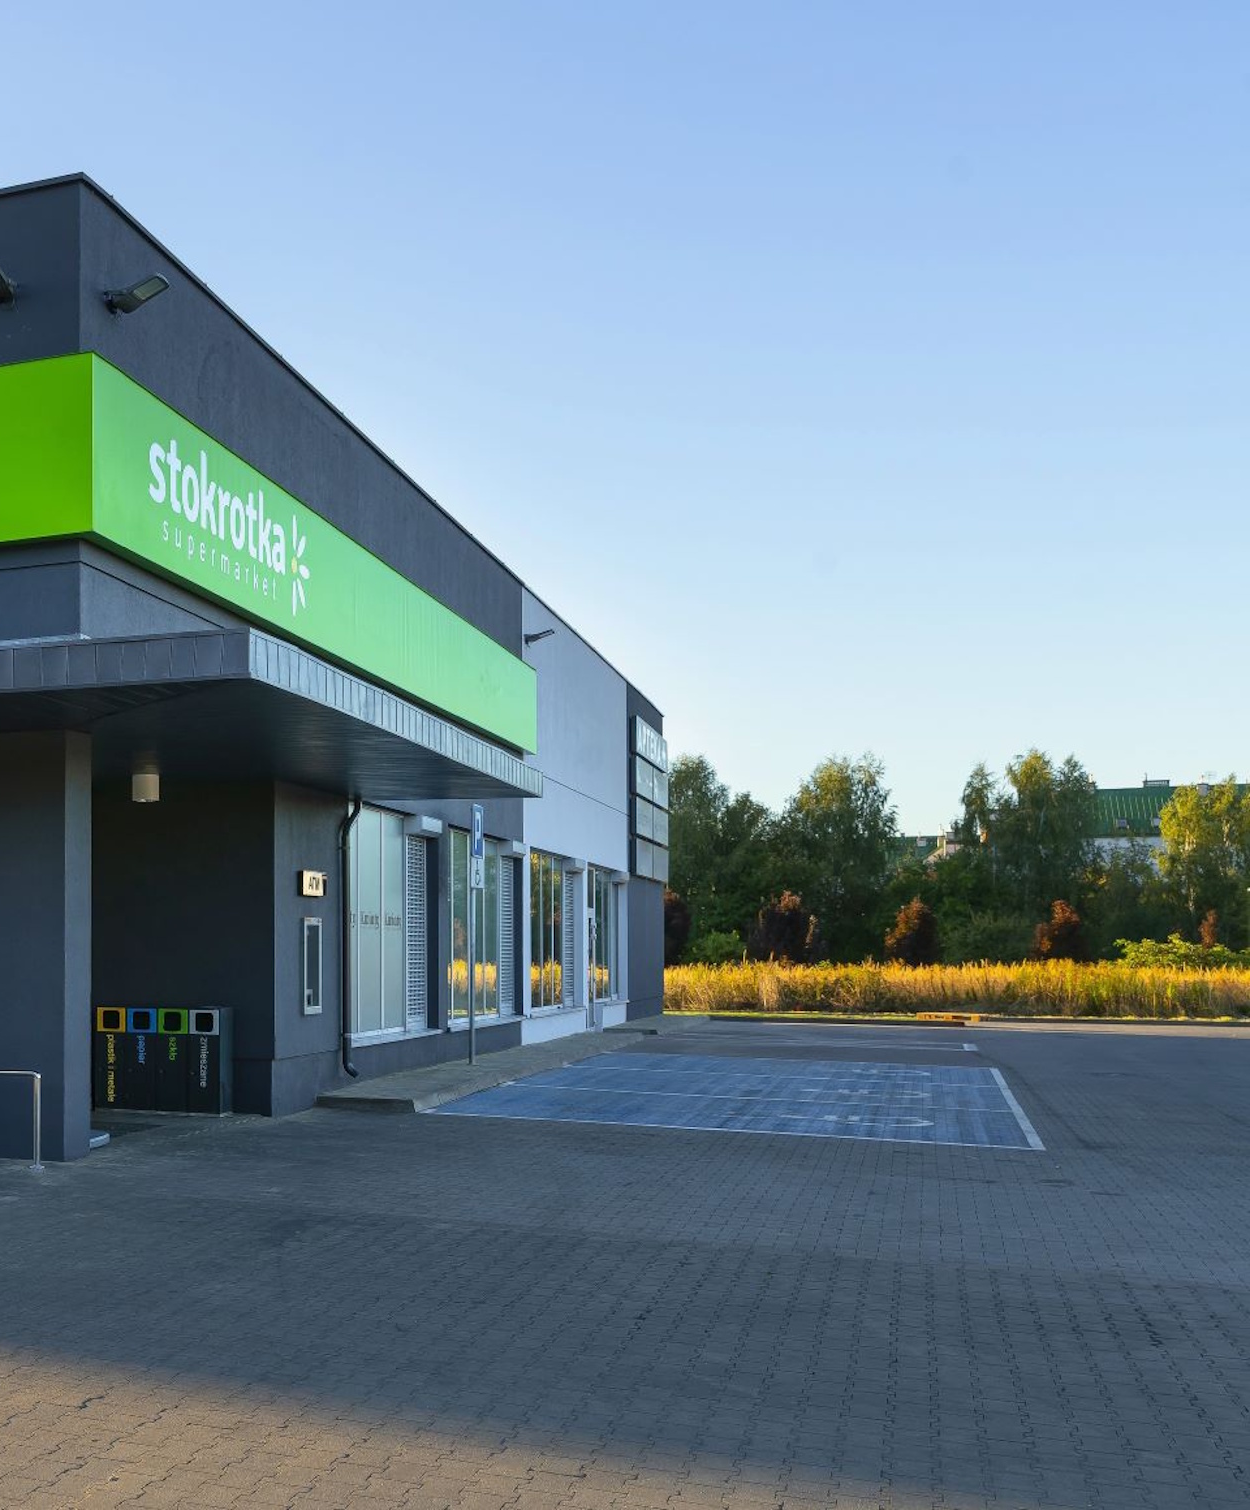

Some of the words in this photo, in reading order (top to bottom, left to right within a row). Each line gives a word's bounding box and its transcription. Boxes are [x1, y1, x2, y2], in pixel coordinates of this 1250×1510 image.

[149, 439, 286, 576] stokrotka
[162, 520, 277, 601] supermarket
[475, 811, 482, 850] P
[106, 1034, 116, 1064] plastik
[136, 1035, 146, 1065] papier
[200, 1036, 209, 1088] zmieszane
[107, 1070, 117, 1103] metale
